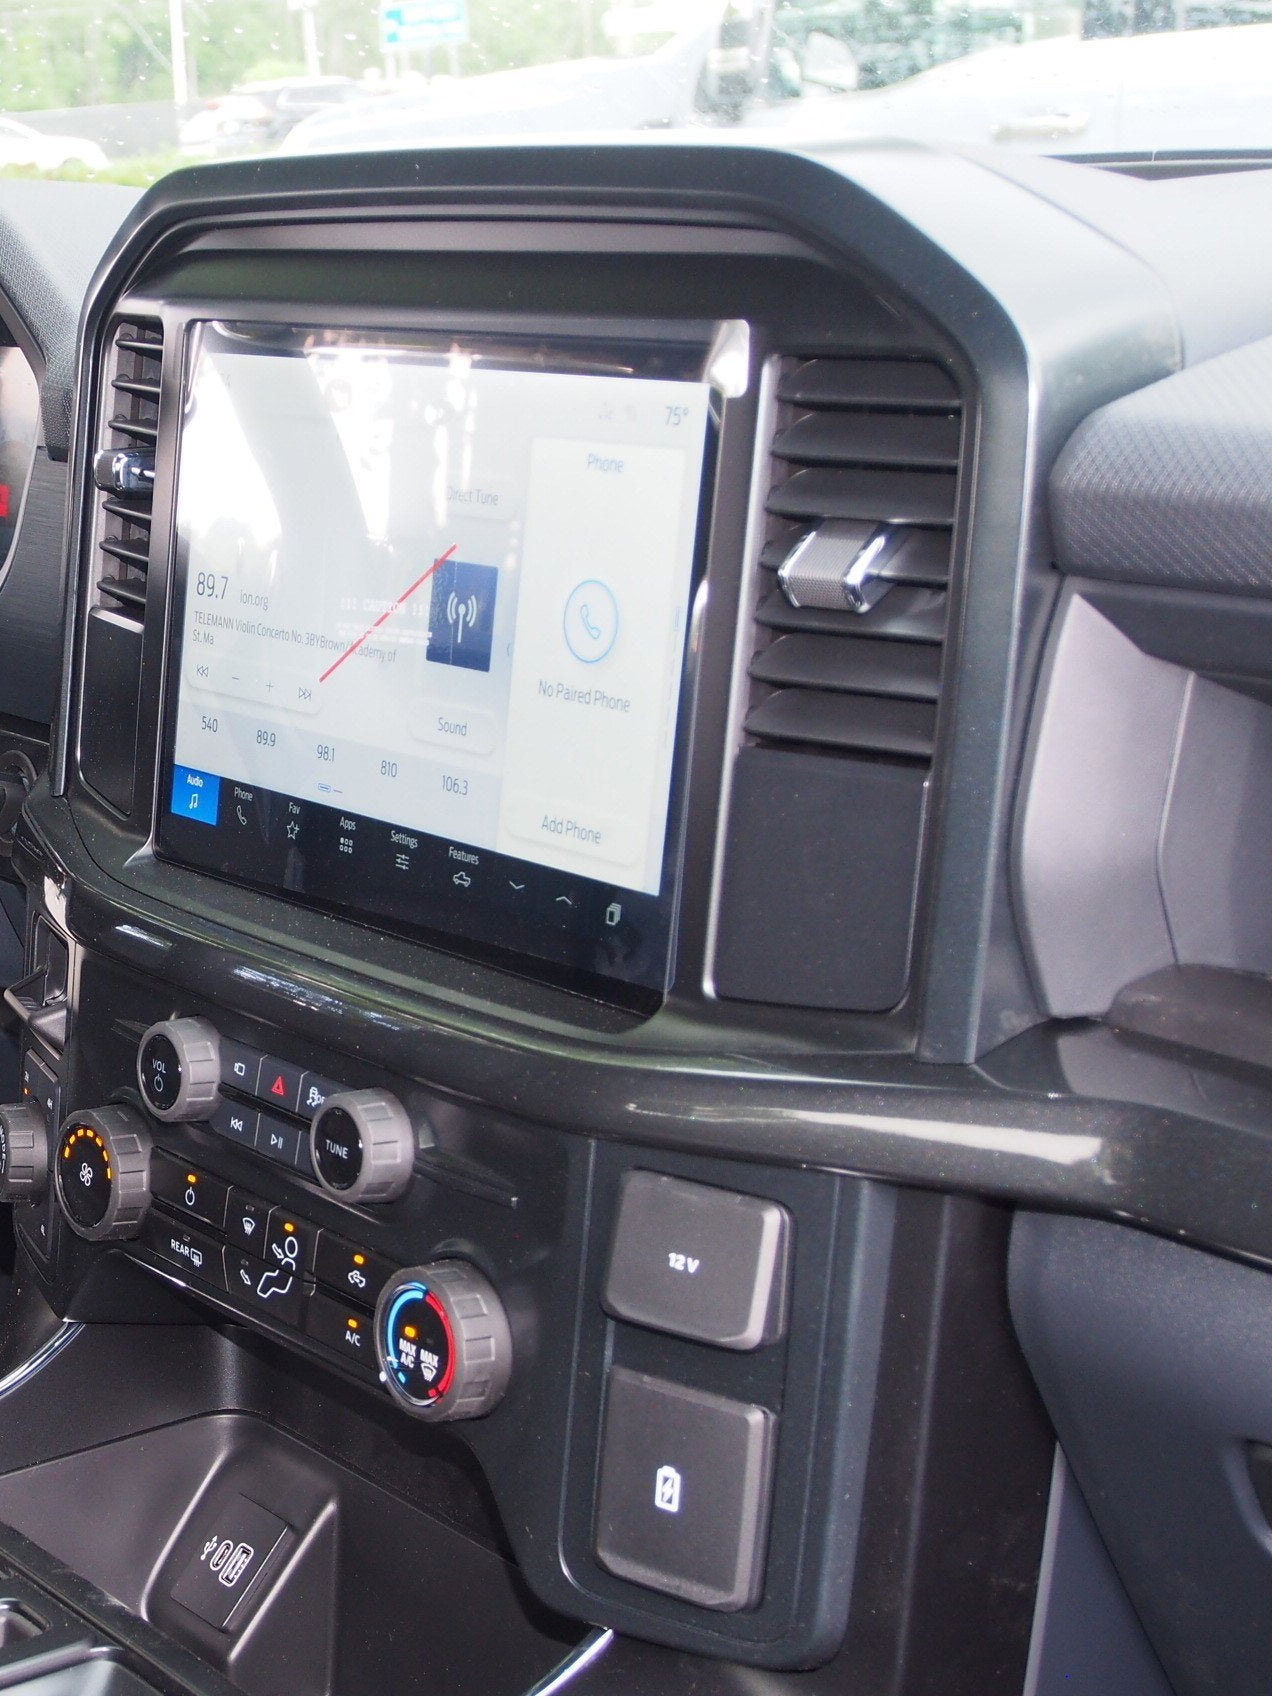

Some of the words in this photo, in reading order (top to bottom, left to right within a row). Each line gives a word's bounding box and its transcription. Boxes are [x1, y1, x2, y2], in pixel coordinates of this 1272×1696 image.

[664, 405, 690, 426] 75°
[586, 453, 625, 474] Phone
[446, 486, 472, 504] Direct
[473, 488, 499, 506] Tune
[196, 571, 229, 600] 89.7
[239, 589, 270, 612] ion.org
[194, 610, 234, 630] TELEMANN
[235, 618, 256, 635] Violin
[257, 622, 290, 641] Concerto
[538, 679, 554, 698] No
[555, 682, 592, 705] Paired
[594, 689, 631, 713] Phone
[201, 716, 218, 733] 540
[437, 717, 468, 737] Sound
[256, 729, 276, 747] 89.9
[316, 744, 336, 763] 98.1
[380, 760, 398, 779] 810
[186, 773, 204, 788] Audio
[441, 774, 469, 796] 106.3
[234, 786, 254, 803] Phone
[288, 802, 301, 815] Fav
[339, 816, 357, 831] Apps
[541, 814, 564, 834] Add
[565, 820, 602, 845] Phone
[390, 830, 419, 849] Settings
[448, 846, 479, 866] Features
[151, 1058, 167, 1074] VOL
[325, 1139, 349, 1159] TUNE
[170, 1238, 190, 1258] REAR
[345, 1329, 361, 1347] A/C
[399, 1337, 417, 1358] MAX
[400, 1352, 415, 1369] A/C
[420, 1348, 439, 1368] MAX
